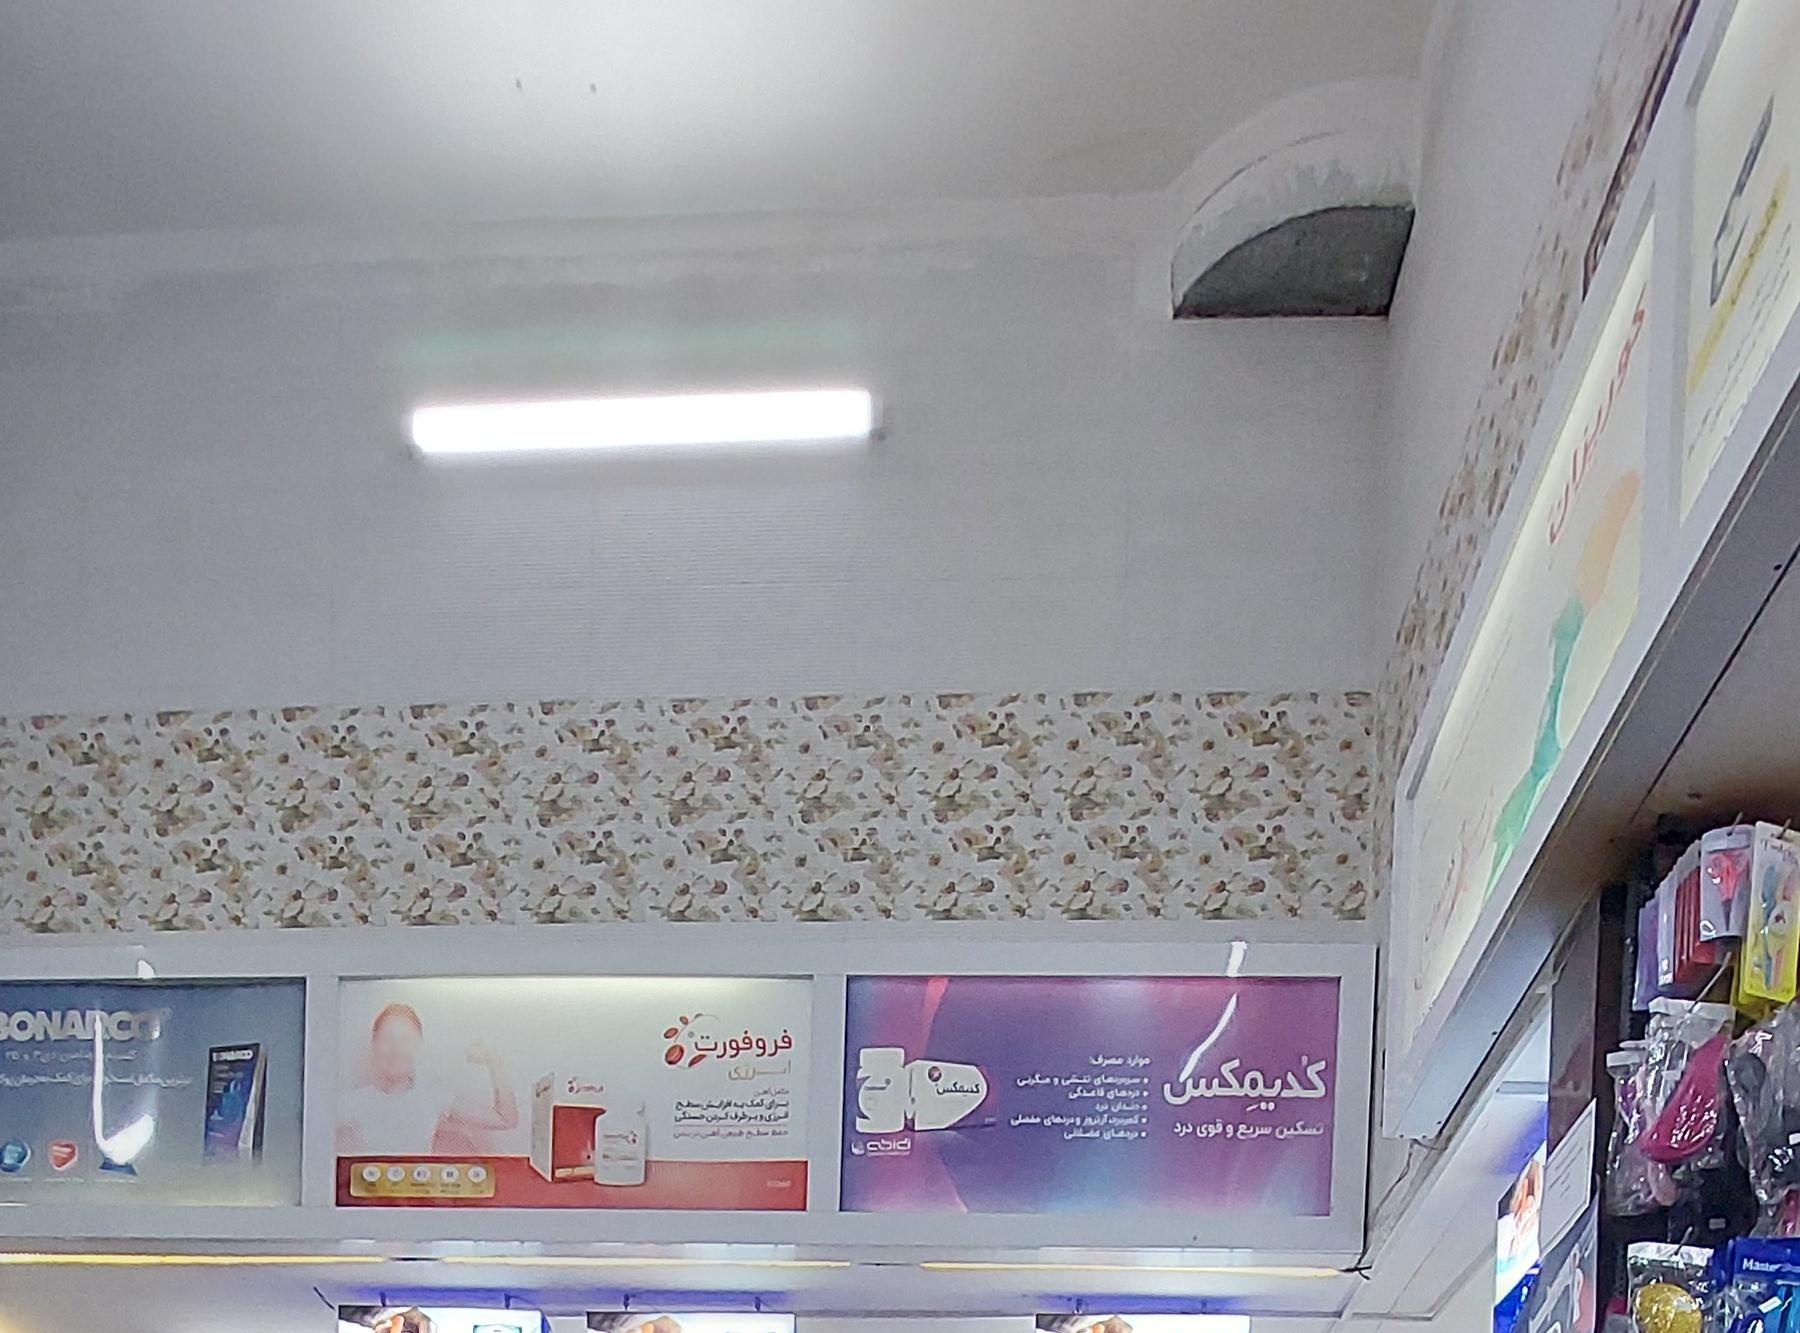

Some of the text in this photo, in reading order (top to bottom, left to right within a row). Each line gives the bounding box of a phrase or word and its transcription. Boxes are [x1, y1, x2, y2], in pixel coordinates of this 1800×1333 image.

[694, 1029, 793, 1058] فروفورت
[1173, 1122, 1193, 1137] درد
[1196, 1119, 1224, 1138] قوی
[1226, 1126, 1234, 1138] و
[1236, 1124, 1272, 1139] سریع
